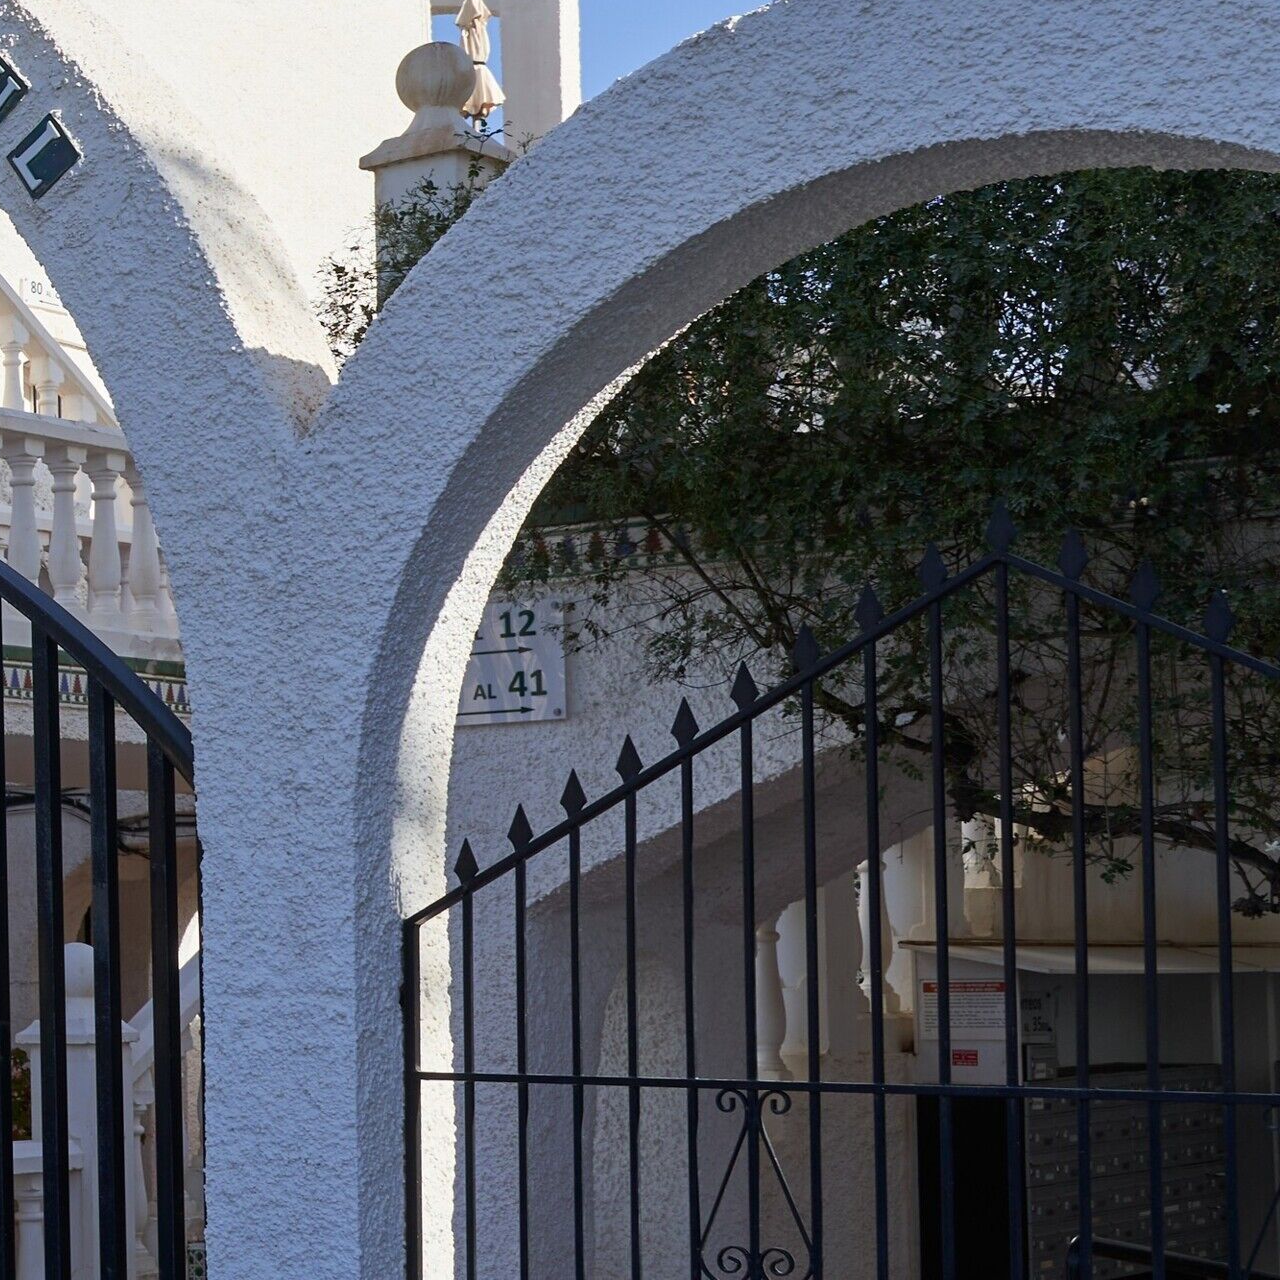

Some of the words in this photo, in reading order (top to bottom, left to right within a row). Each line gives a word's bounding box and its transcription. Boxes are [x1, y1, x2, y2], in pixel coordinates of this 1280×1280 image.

[30, 281, 43, 295] 80
[499, 609, 537, 639] 12
[473, 683, 497, 700] AL
[508, 669, 548, 697] 41
